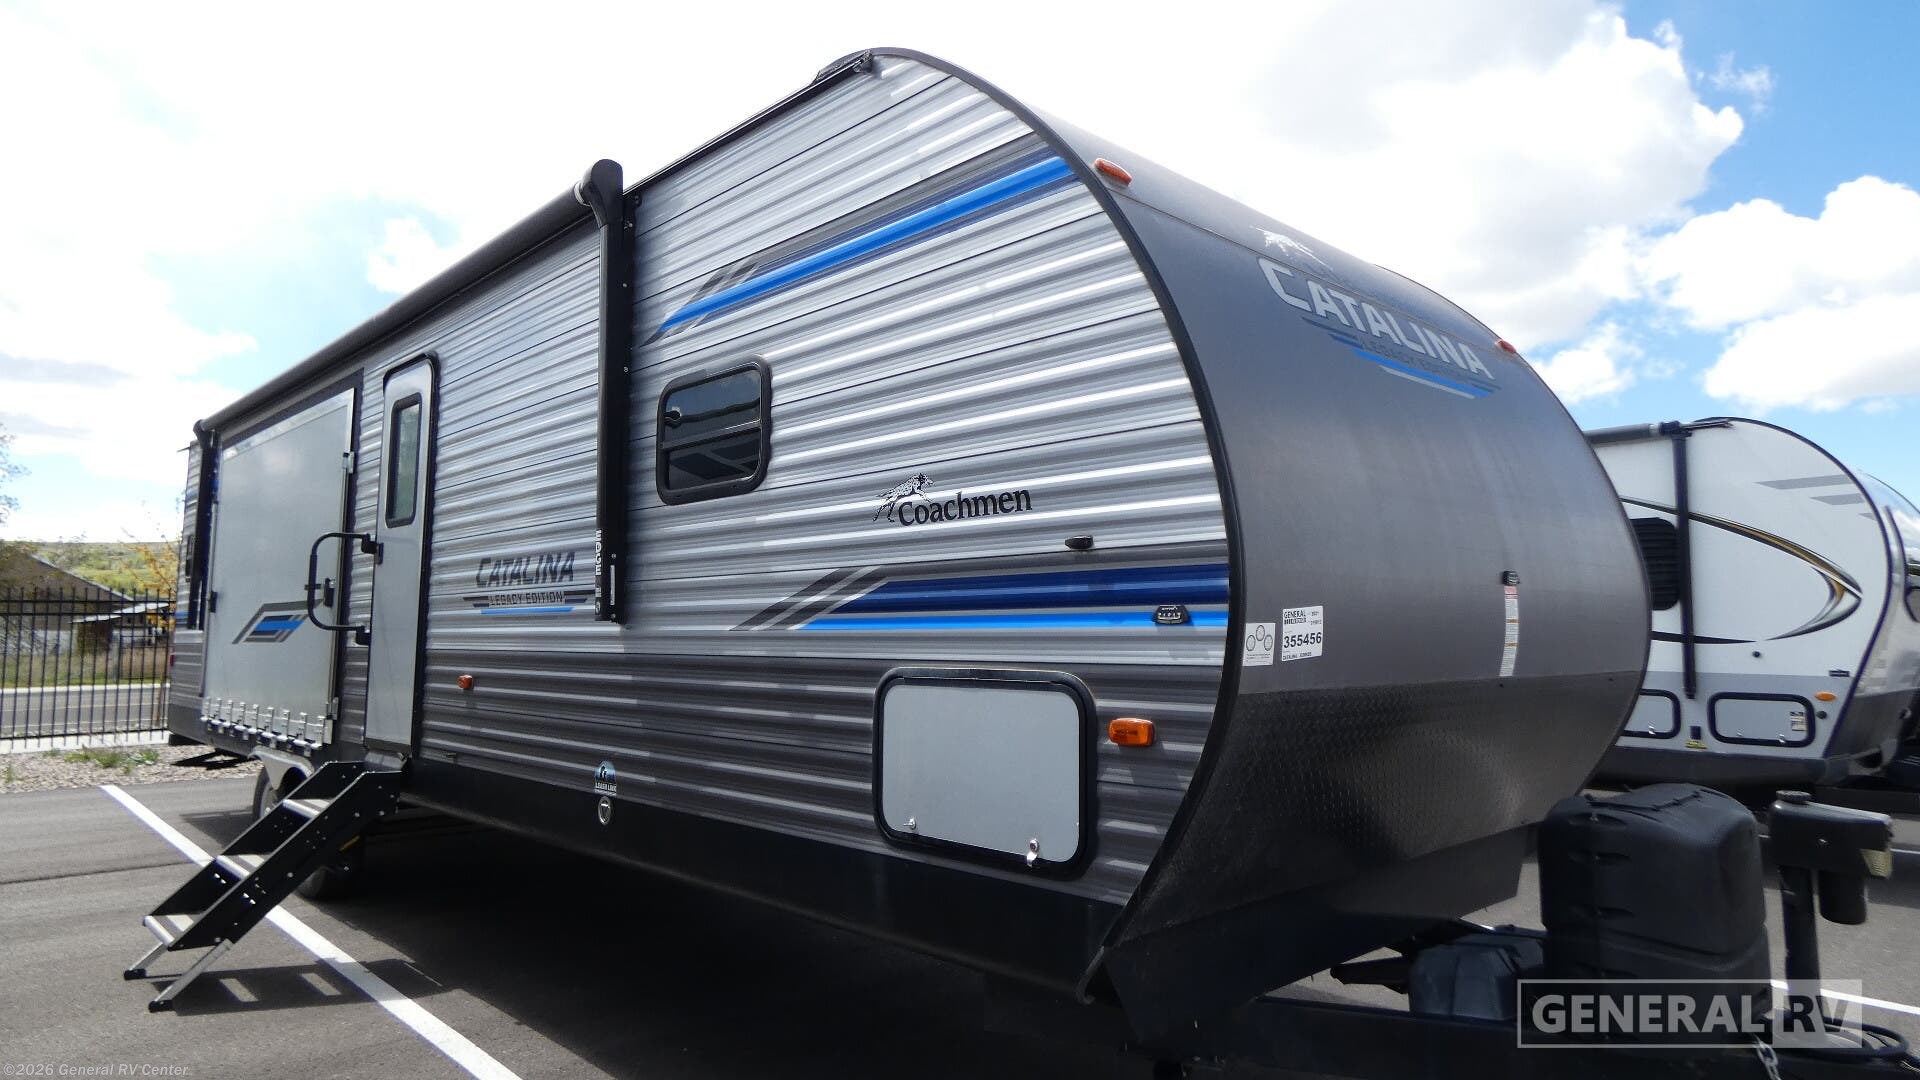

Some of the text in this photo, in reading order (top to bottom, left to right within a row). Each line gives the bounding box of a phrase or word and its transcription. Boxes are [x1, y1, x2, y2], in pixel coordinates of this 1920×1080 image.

[1257, 257, 1495, 379] CATALINA
[899, 489, 1033, 526] Coachmen
[475, 551, 576, 588] CATALINA
[490, 591, 563, 606] LEGACY EDITION
[1284, 610, 1306, 619] GENERAL
[1283, 632, 1322, 648] 355456
